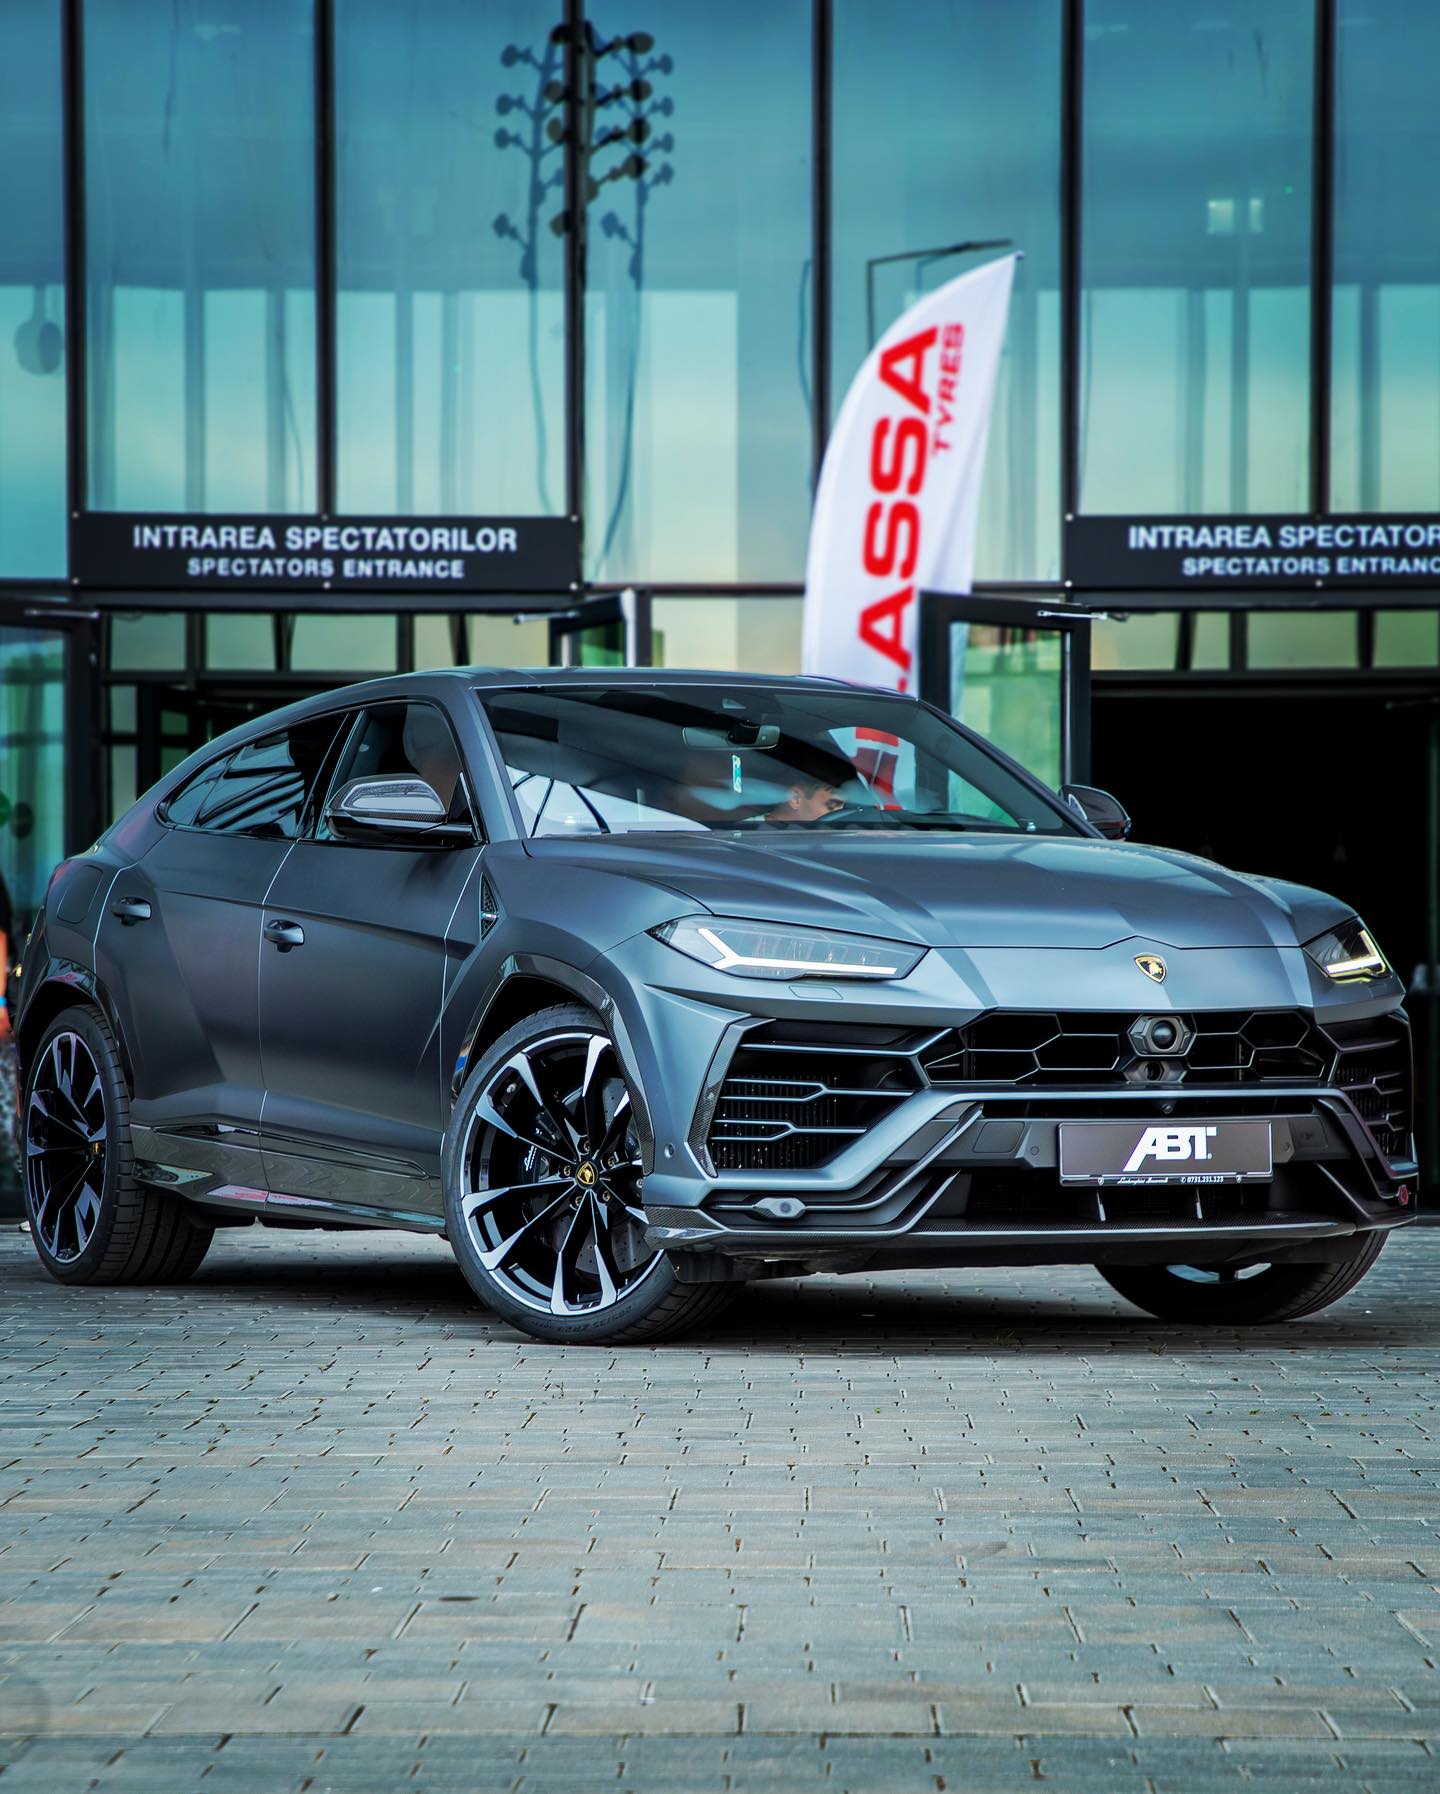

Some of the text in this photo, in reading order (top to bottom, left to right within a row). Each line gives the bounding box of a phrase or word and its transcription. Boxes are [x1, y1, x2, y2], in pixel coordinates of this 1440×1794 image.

[931, 321, 966, 458] TYRES
[133, 525, 518, 553] INTRAREA SPECTATORILOR
[1128, 524, 1440, 550] INTRAREA SPECTATOR
[187, 557, 465, 579] SPECTATORS ENTRANCE
[1182, 556, 1440, 577] SPECTATORS ENTRANC
[1122, 1126, 1217, 1172] ABT
